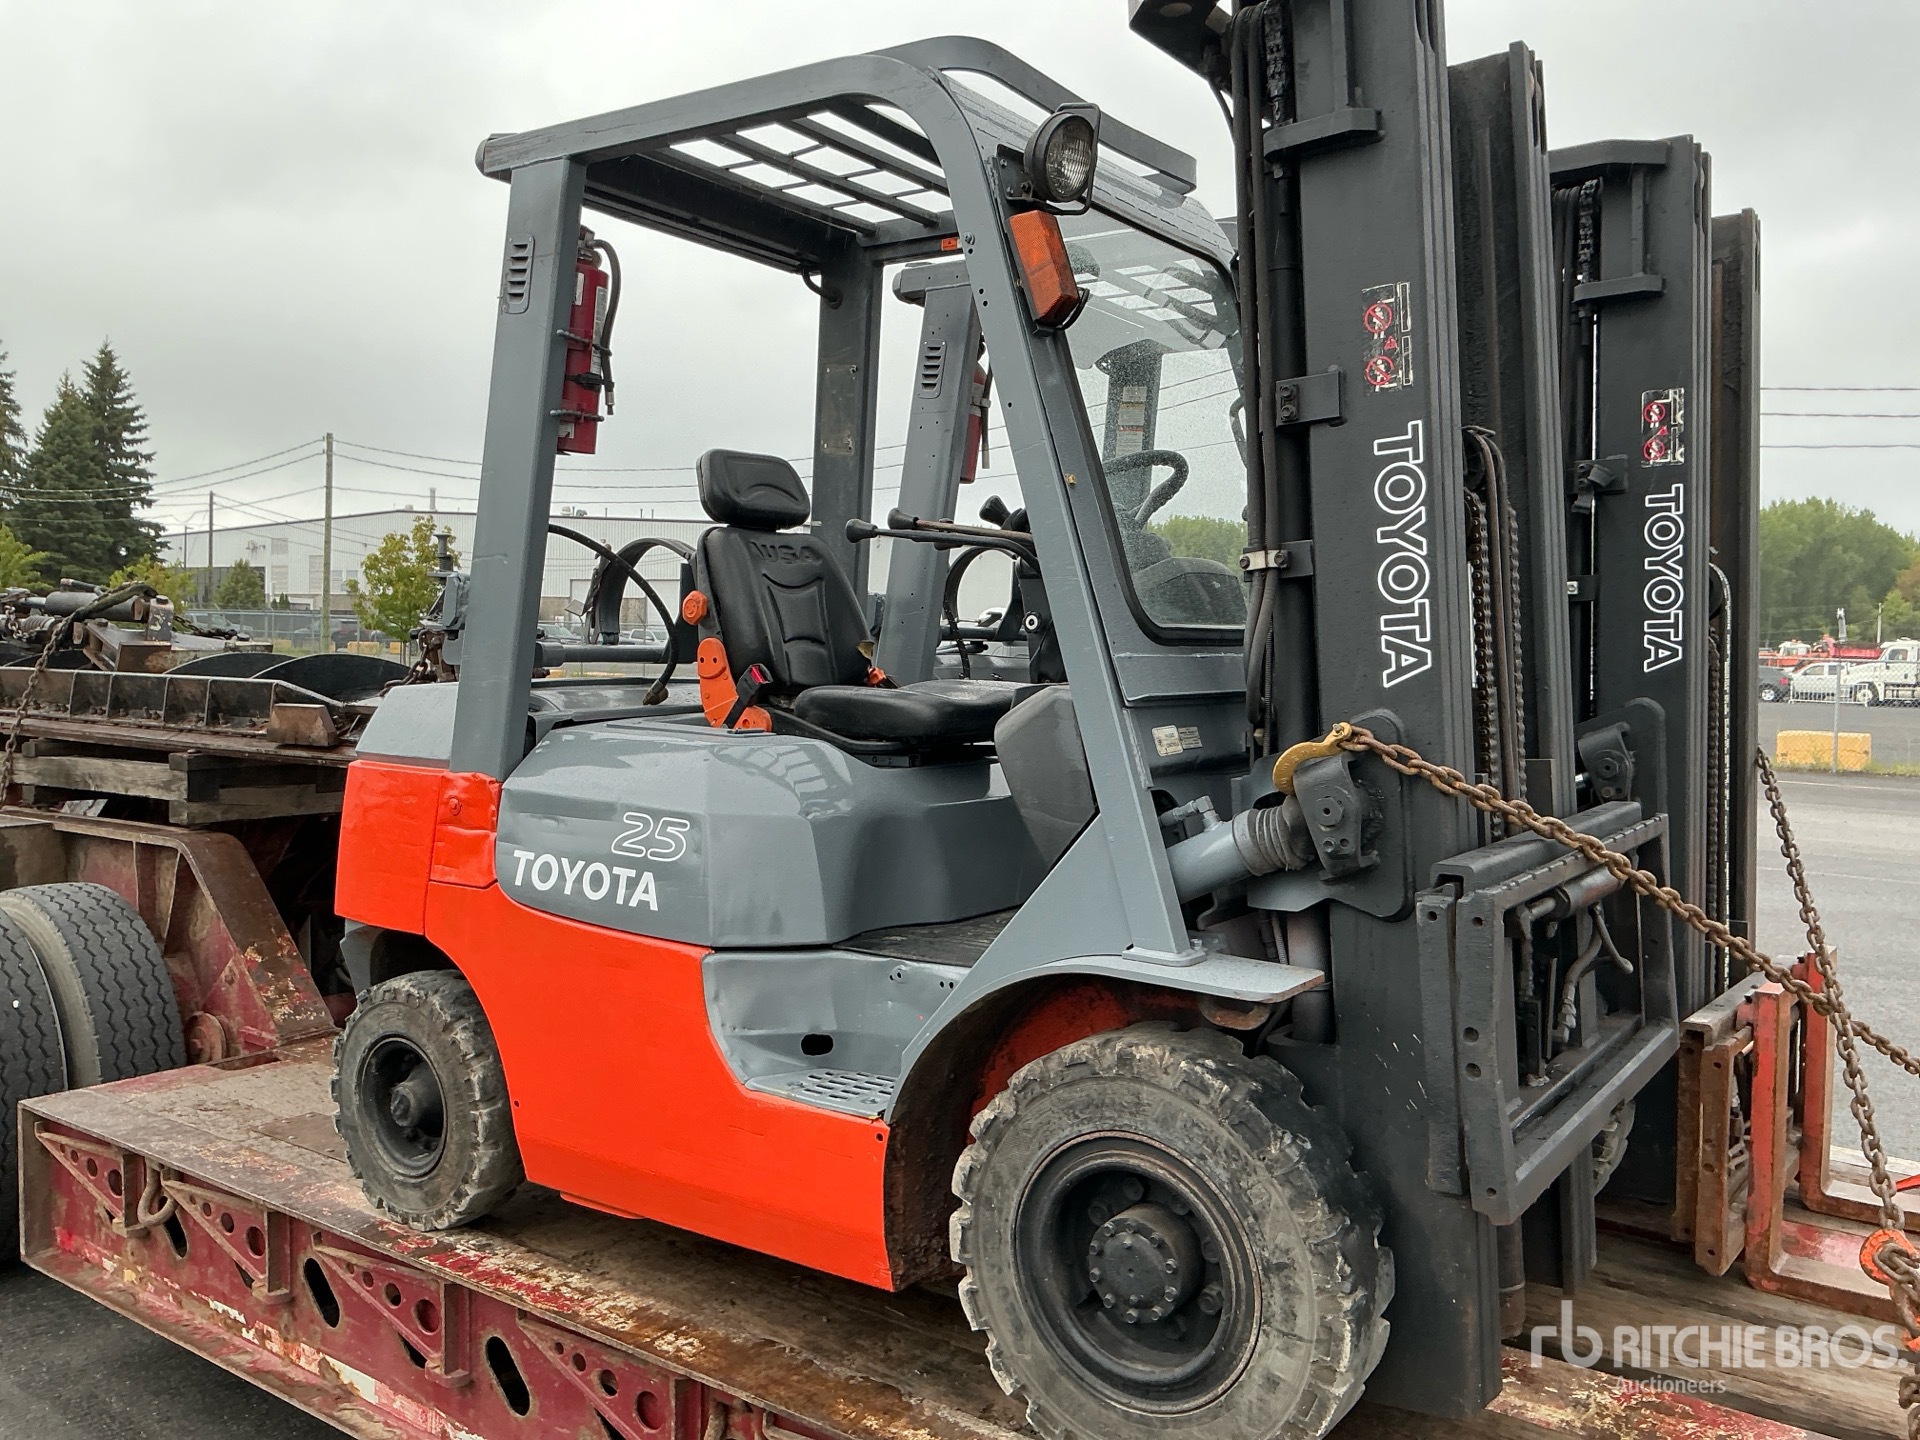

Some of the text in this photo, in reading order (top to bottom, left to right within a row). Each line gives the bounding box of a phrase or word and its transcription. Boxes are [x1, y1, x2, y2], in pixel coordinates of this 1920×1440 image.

[1373, 419, 1432, 689] TOYOTA
[1643, 483, 1684, 673] TOYOTA
[513, 849, 659, 911] TOYOTA
[611, 811, 691, 862] 25
